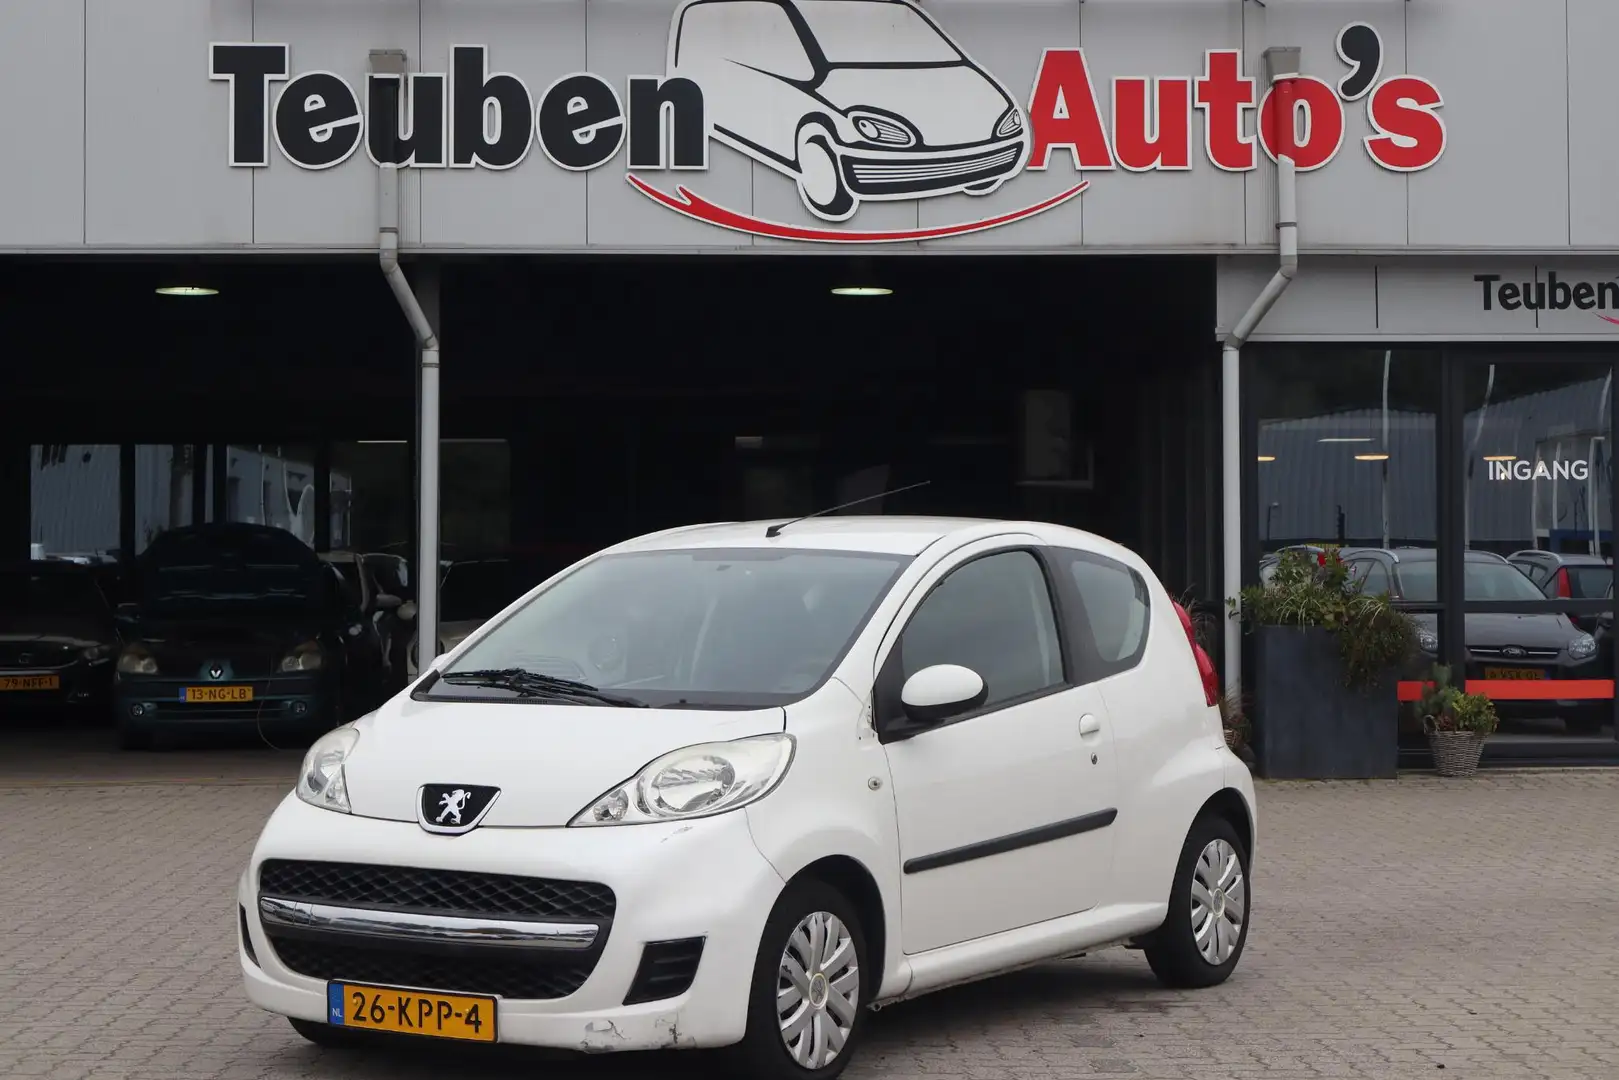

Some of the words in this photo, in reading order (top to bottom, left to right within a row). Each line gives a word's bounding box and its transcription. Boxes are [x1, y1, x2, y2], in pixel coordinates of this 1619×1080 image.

[209, 42, 709, 170] Teuben
[1027, 21, 1447, 171] Auto's
[1474, 271, 1619, 310] Teuben
[1488, 460, 1588, 480] INGANG
[191, 687, 247, 700] 13-NG-LB
[332, 1007, 343, 1018] NL
[352, 991, 482, 1033] 26-KPP-4
